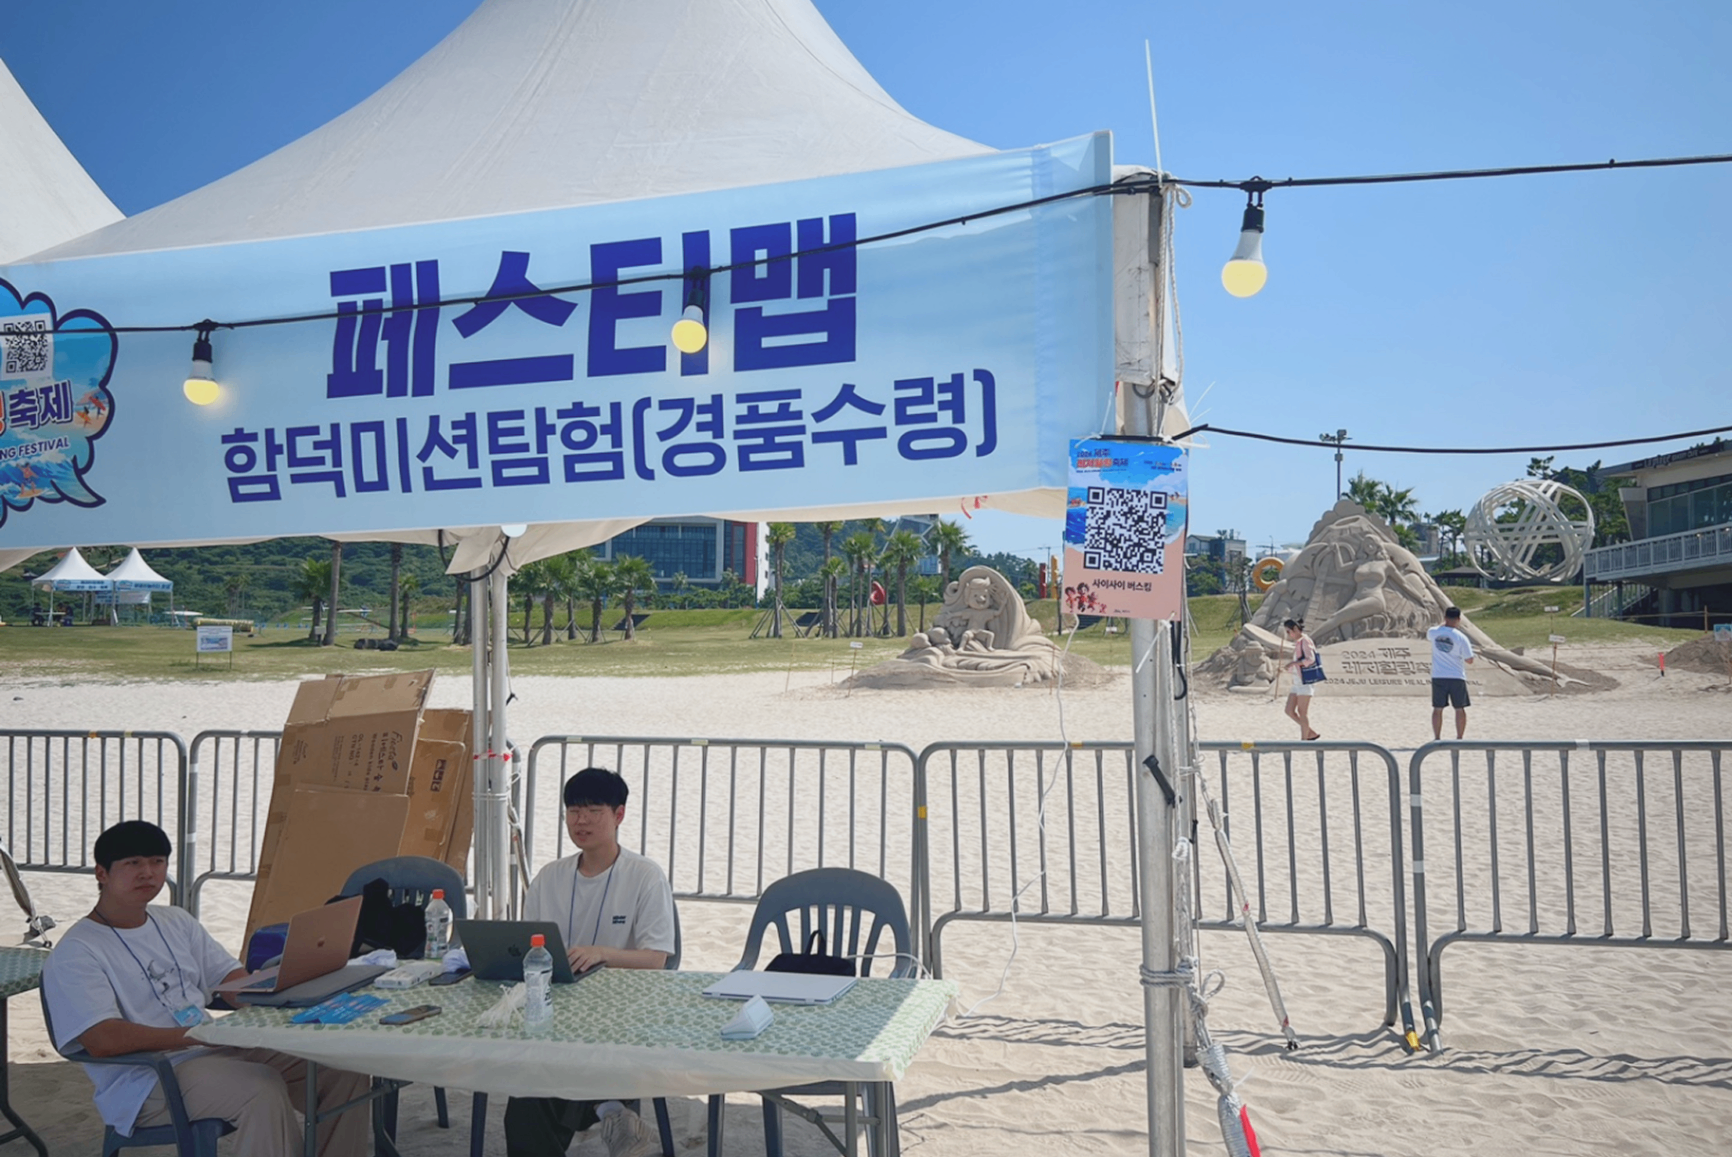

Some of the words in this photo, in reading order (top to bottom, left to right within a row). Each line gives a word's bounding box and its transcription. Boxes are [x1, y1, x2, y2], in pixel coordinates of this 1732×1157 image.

[327, 213, 858, 398] 페스티맵
[0, 381, 71, 433] 축제
[222, 369, 997, 503] 함덕미션탐험(경품수령)
[19, 437, 69, 456] FESTIVAL
[1092, 578, 1125, 590] 사이사이
[1127, 581, 1152, 592] 버스킹
[1342, 650, 1377, 661] 2024
[1378, 647, 1412, 660] 제주
[1342, 661, 1432, 676] 레저힐링축
[1345, 678, 1366, 686] JEJU
[1404, 679, 1432, 687] HEALIN
